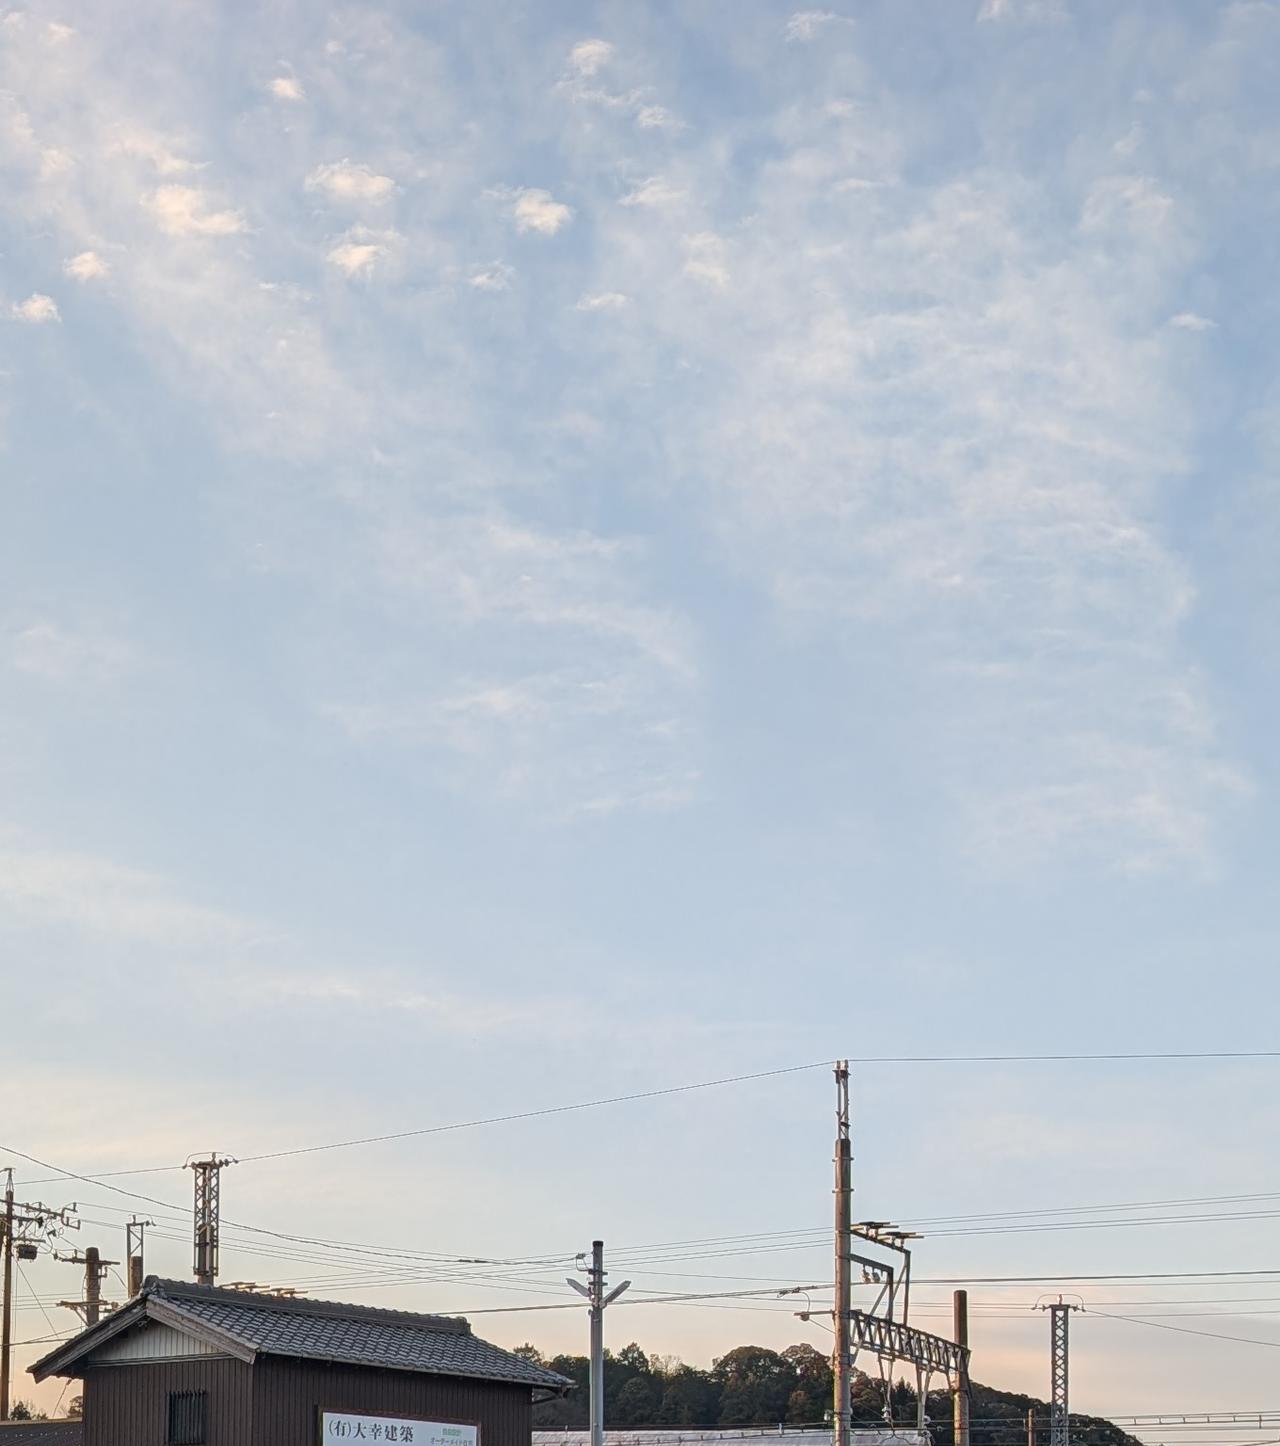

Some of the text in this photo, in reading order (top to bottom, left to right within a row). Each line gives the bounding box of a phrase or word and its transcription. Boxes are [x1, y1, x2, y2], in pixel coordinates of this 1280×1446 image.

[328, 1420, 414, 1443] (有)大幸建築
